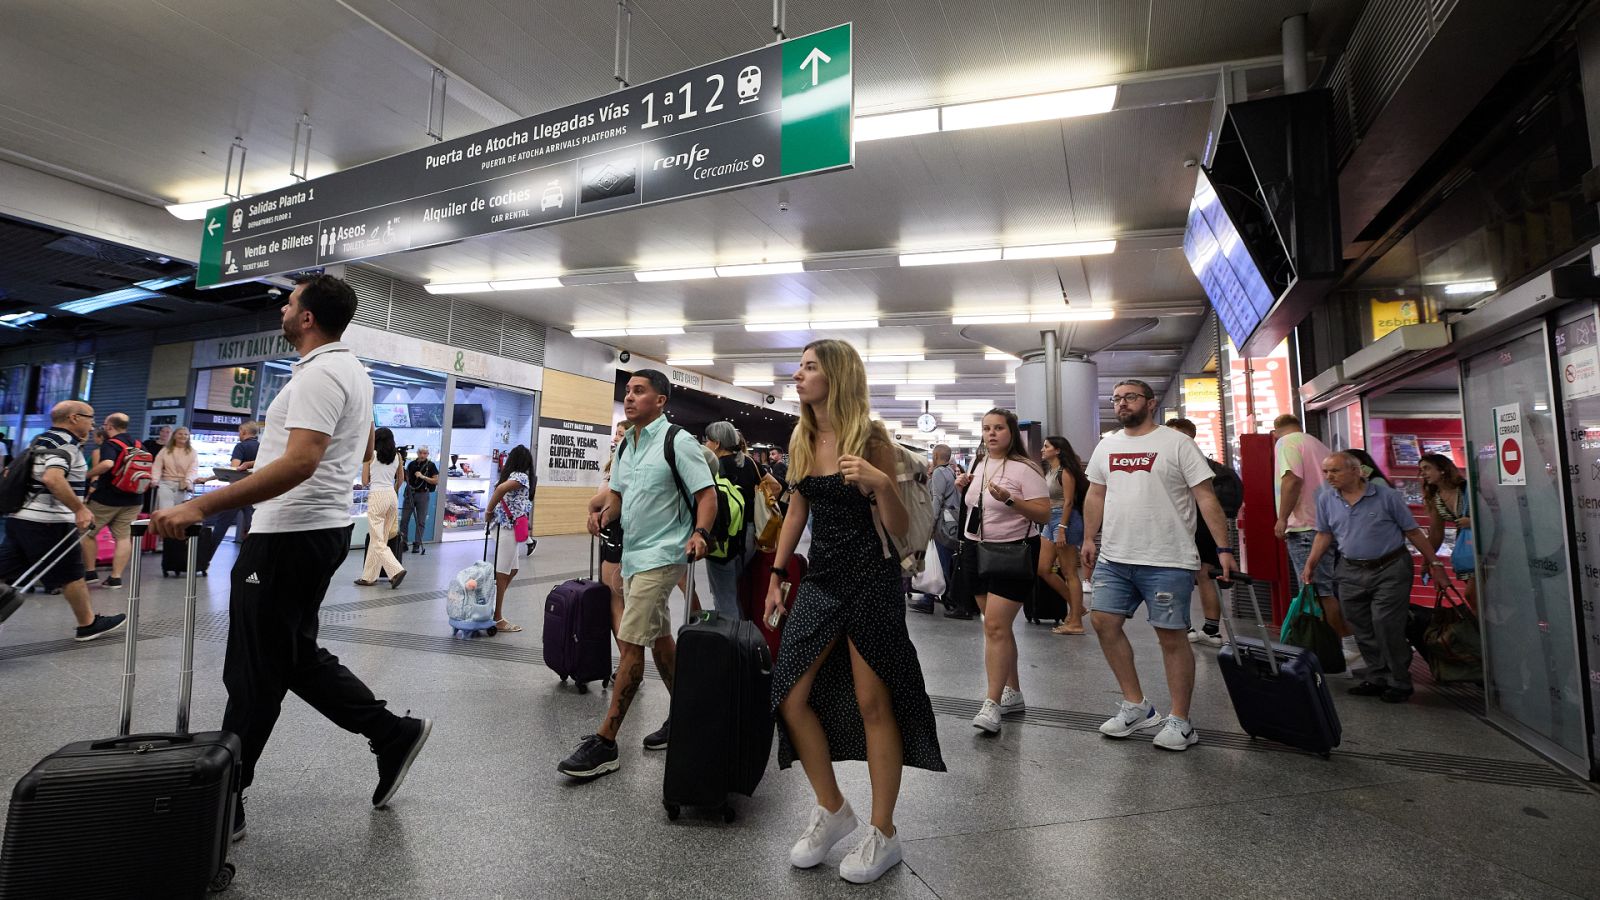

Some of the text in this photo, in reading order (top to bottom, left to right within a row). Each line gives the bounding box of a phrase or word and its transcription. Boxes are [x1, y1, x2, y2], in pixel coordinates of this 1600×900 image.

[425, 74, 725, 170] Puerta de Atocha Llegadas Vías 1 a 12
[662, 114, 673, 124] TO
[481, 126, 627, 170] PUERTA DE ATOCHA ARRIVALS PLATFORMS
[653, 143, 710, 171] renfe
[693, 158, 749, 180] Cercanías
[248, 188, 314, 217] Salidas Planta 1
[423, 188, 531, 222] Alquiler de coches
[247, 216, 274, 229] DEPARTURES
[491, 210, 530, 224] CAR RENTAL
[337, 224, 366, 241] Aseos
[244, 234, 314, 258] Venta de Billetes
[242, 262, 257, 271] TICKET
[218, 335, 296, 360] TASTY DAILY FOO
[1499, 424, 1520, 436] CERRADO
[550, 434, 598, 450] FOODIES, VEGANS,
[549, 446, 586, 459] GLUTEN-FREE
[548, 458, 600, 472] & HEALTHY LOVERS,
